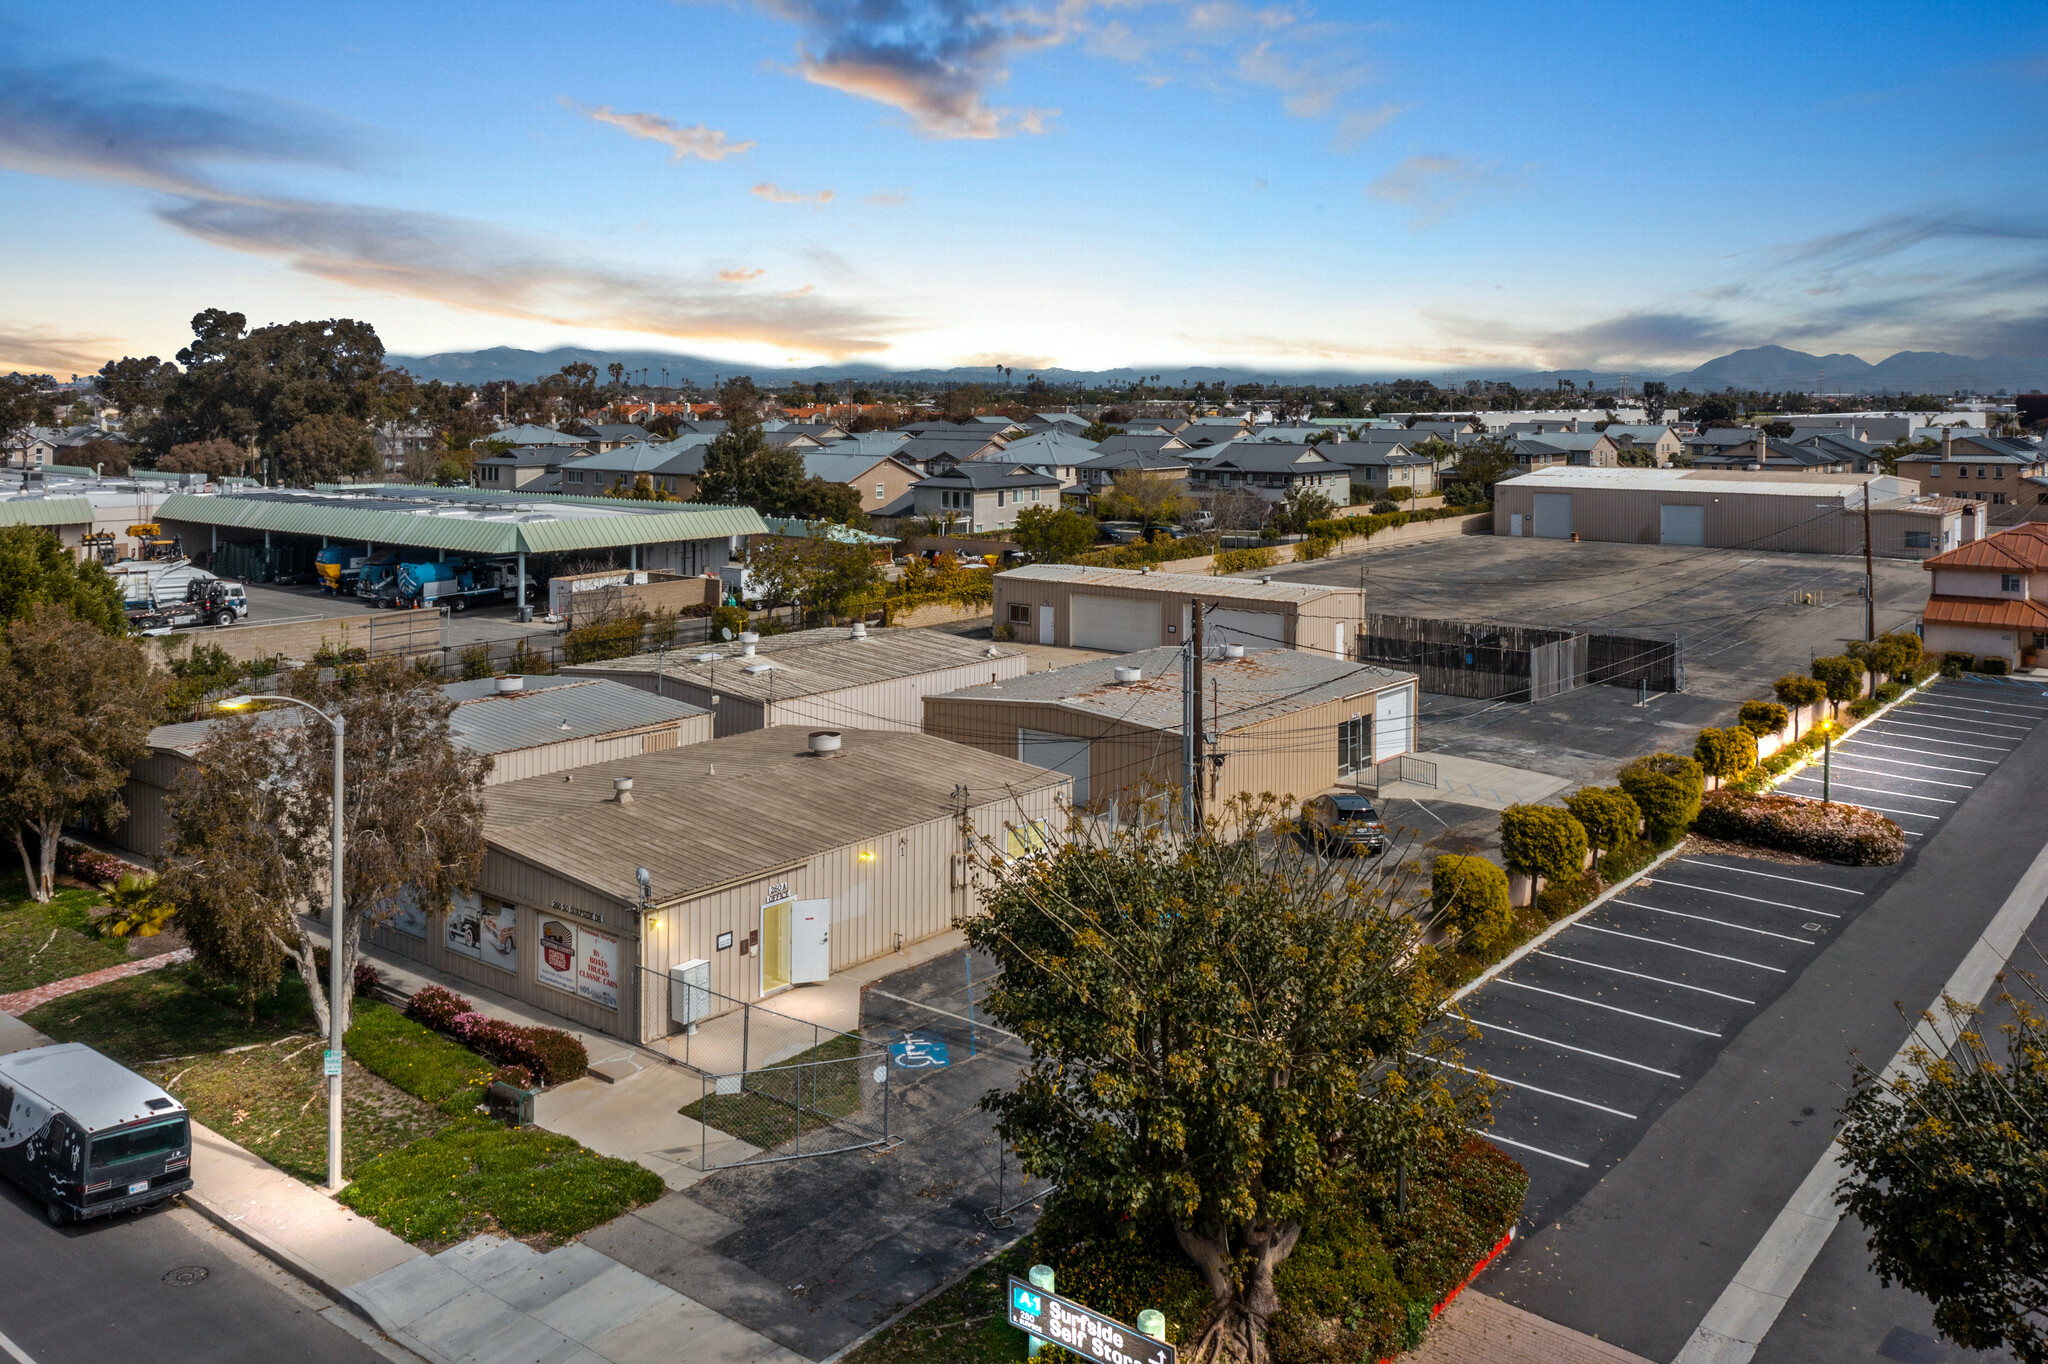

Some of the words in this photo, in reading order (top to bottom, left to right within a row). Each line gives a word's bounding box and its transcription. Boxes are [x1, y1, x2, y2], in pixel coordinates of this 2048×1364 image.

[768, 890, 789, 901] OFFICE
[587, 963, 610, 978] TRUCKS
[589, 955, 608, 968] BOATS
[579, 969, 602, 984] CLASSIC
[602, 977, 618, 990] CARS
[1049, 1301, 1124, 1349] Surfside
[1049, 1318, 1087, 1348] Self
